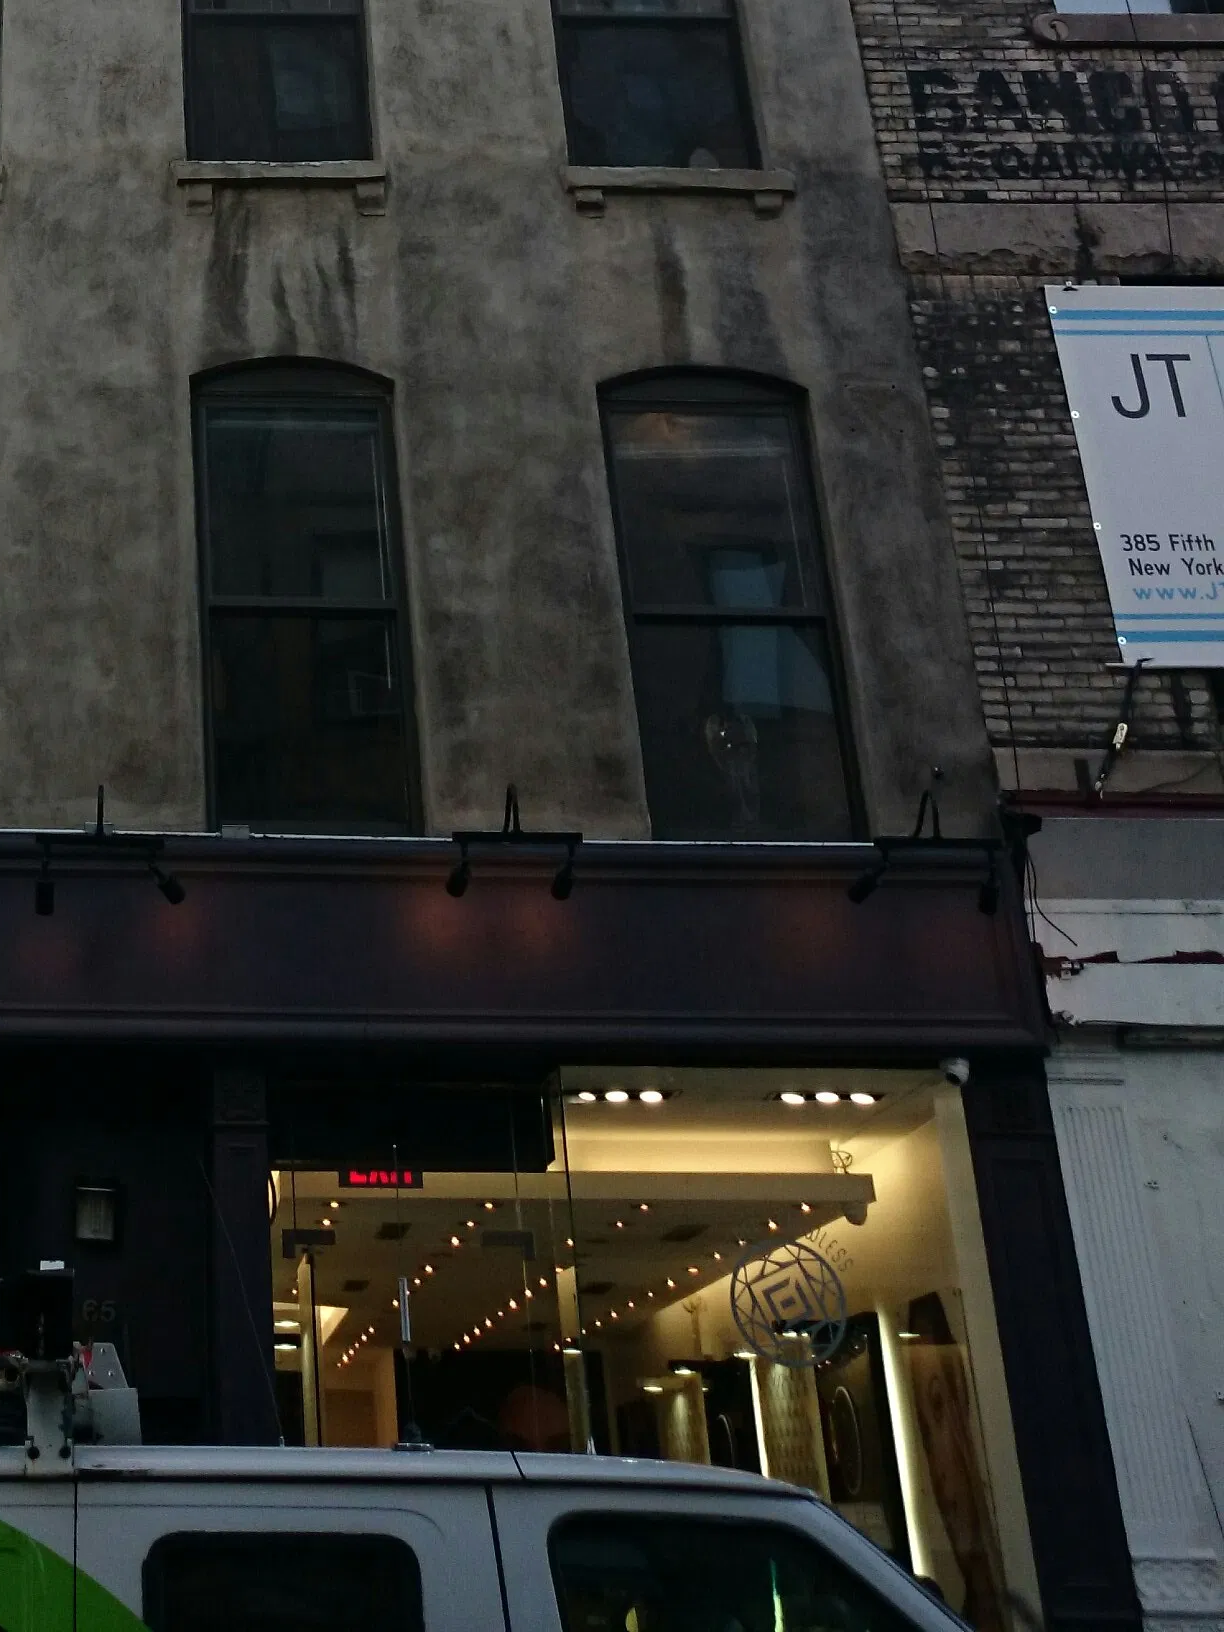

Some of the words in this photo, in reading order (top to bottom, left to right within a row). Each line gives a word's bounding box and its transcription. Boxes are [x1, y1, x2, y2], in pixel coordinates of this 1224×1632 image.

[1110, 352, 1192, 420] JT
[1120, 534, 1160, 552] 385
[1169, 533, 1215, 552] Fifth
[1129, 558, 1170, 576] New
[1181, 558, 1224, 576] York
[81, 1298, 117, 1323] 65
